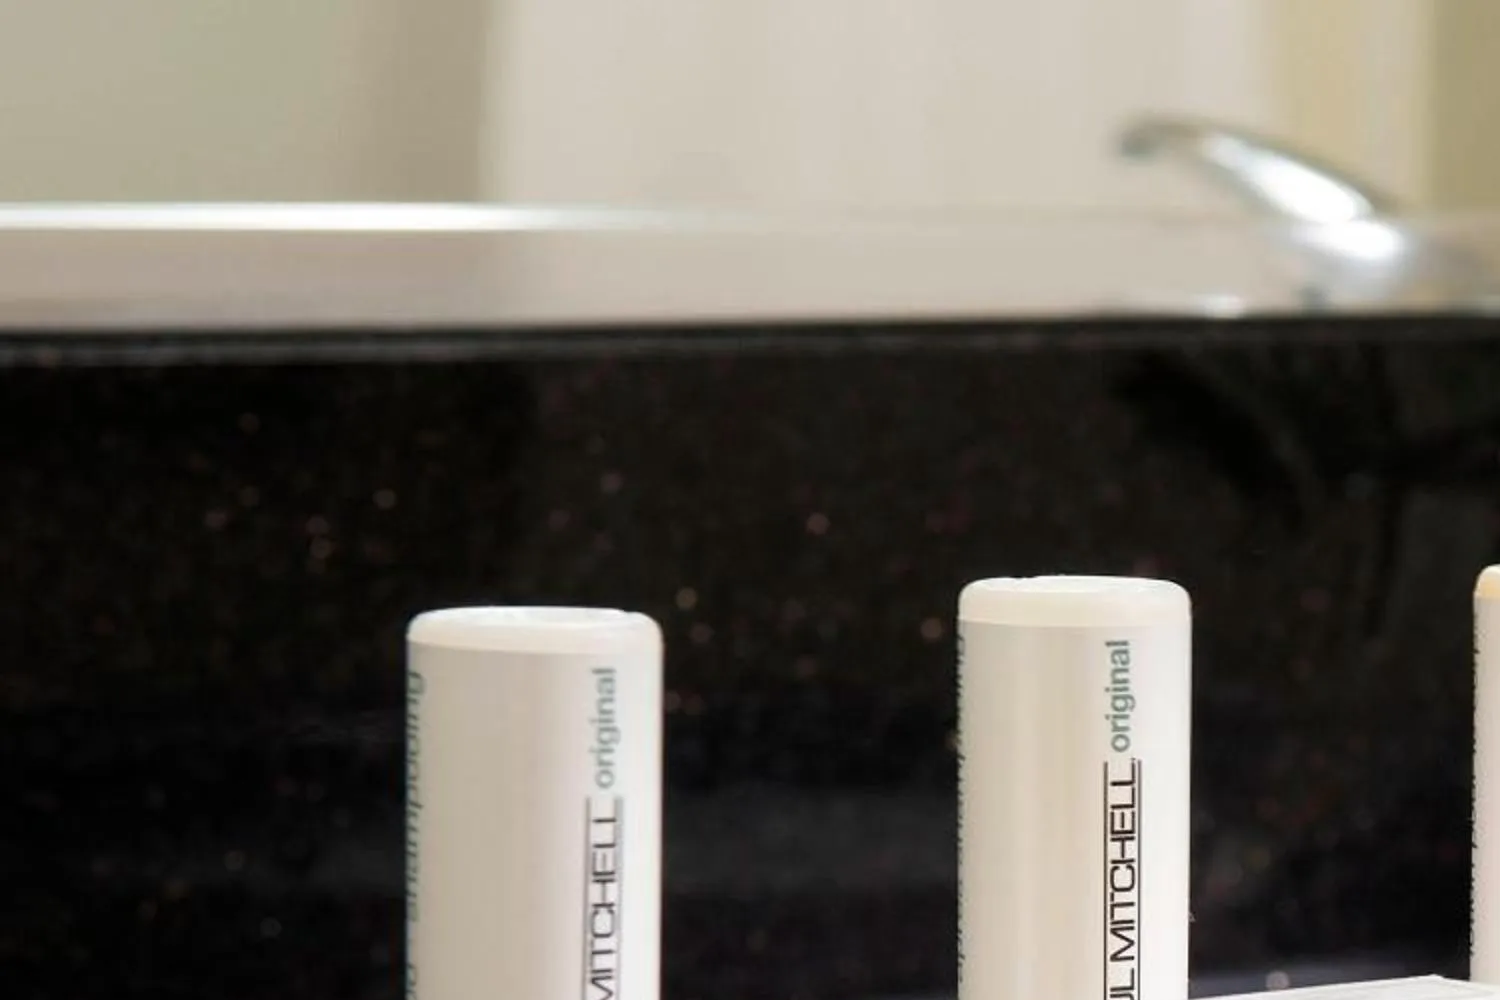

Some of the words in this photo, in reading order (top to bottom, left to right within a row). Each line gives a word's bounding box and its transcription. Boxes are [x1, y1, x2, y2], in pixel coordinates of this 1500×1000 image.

[588, 667, 622, 790] original
[1104, 640, 1137, 753] original
[1109, 758, 1136, 962] MITCHELL
